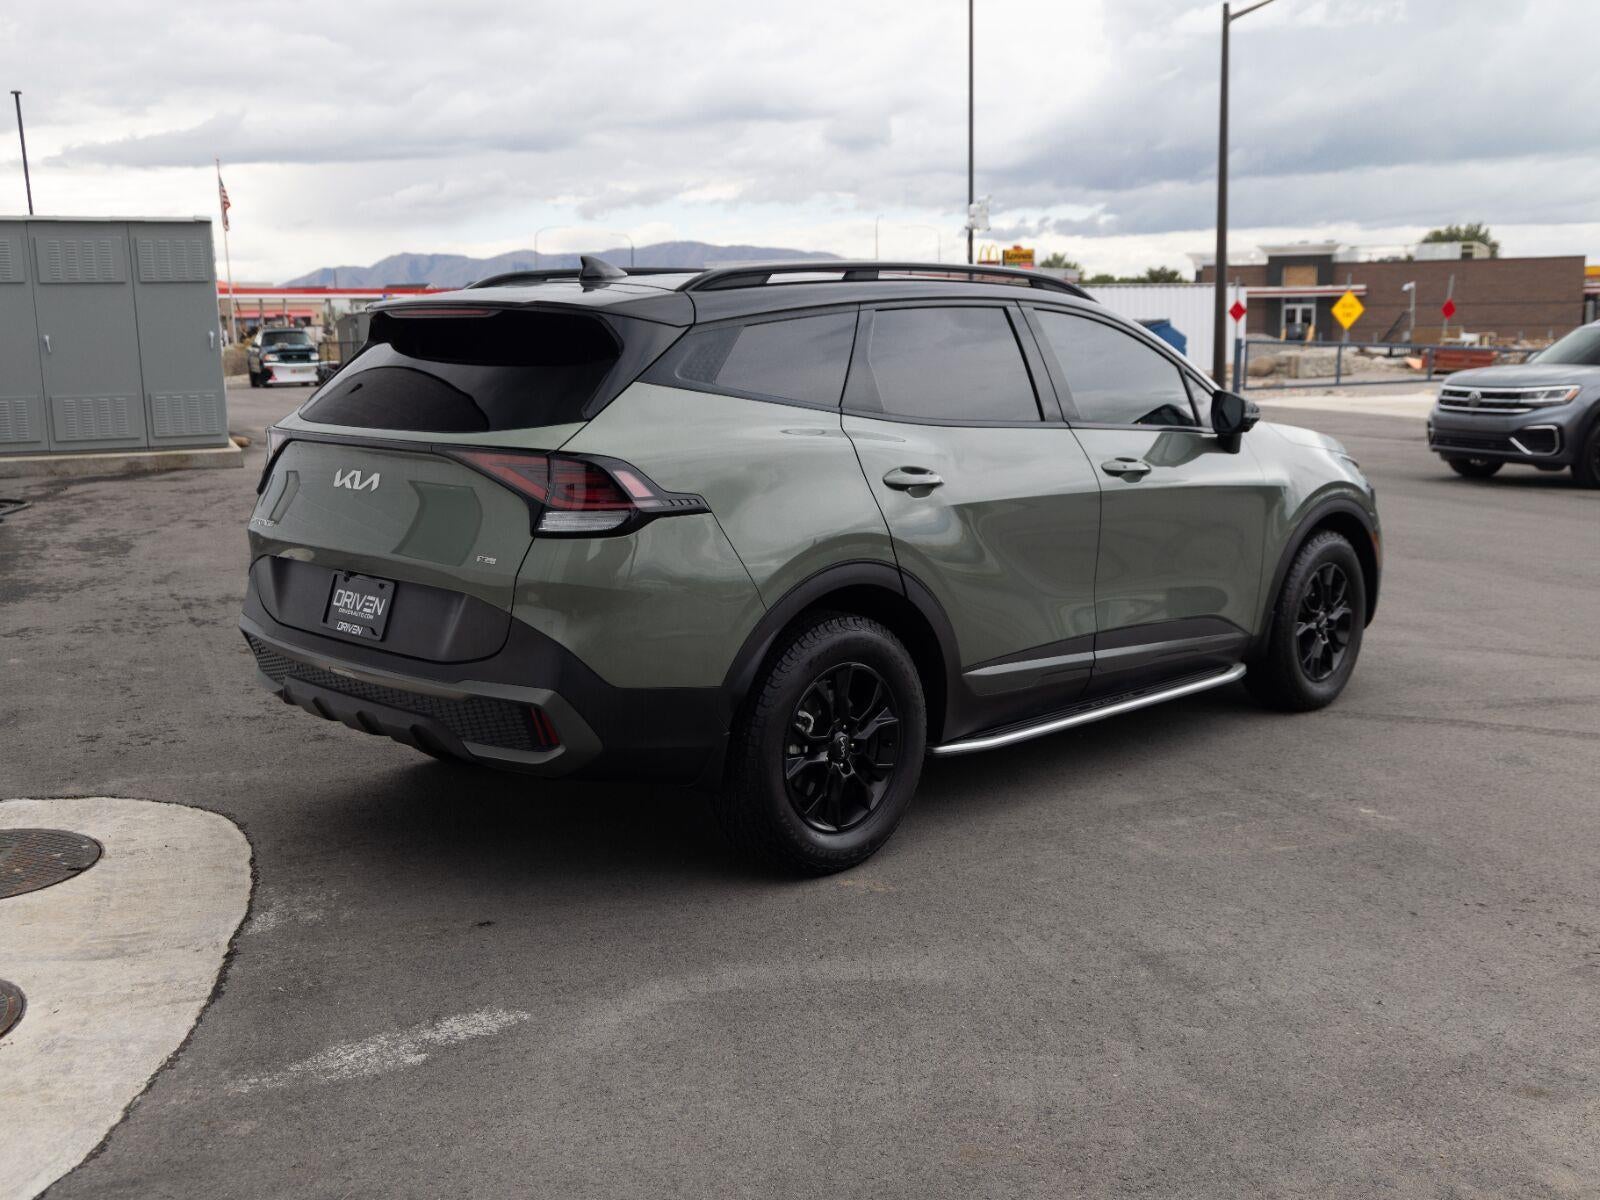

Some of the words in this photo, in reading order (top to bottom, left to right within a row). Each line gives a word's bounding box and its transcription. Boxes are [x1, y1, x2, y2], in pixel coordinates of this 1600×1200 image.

[333, 468, 380, 491] KIA
[333, 589, 386, 615] DRIVEN
[336, 621, 363, 635] DRIVEN
